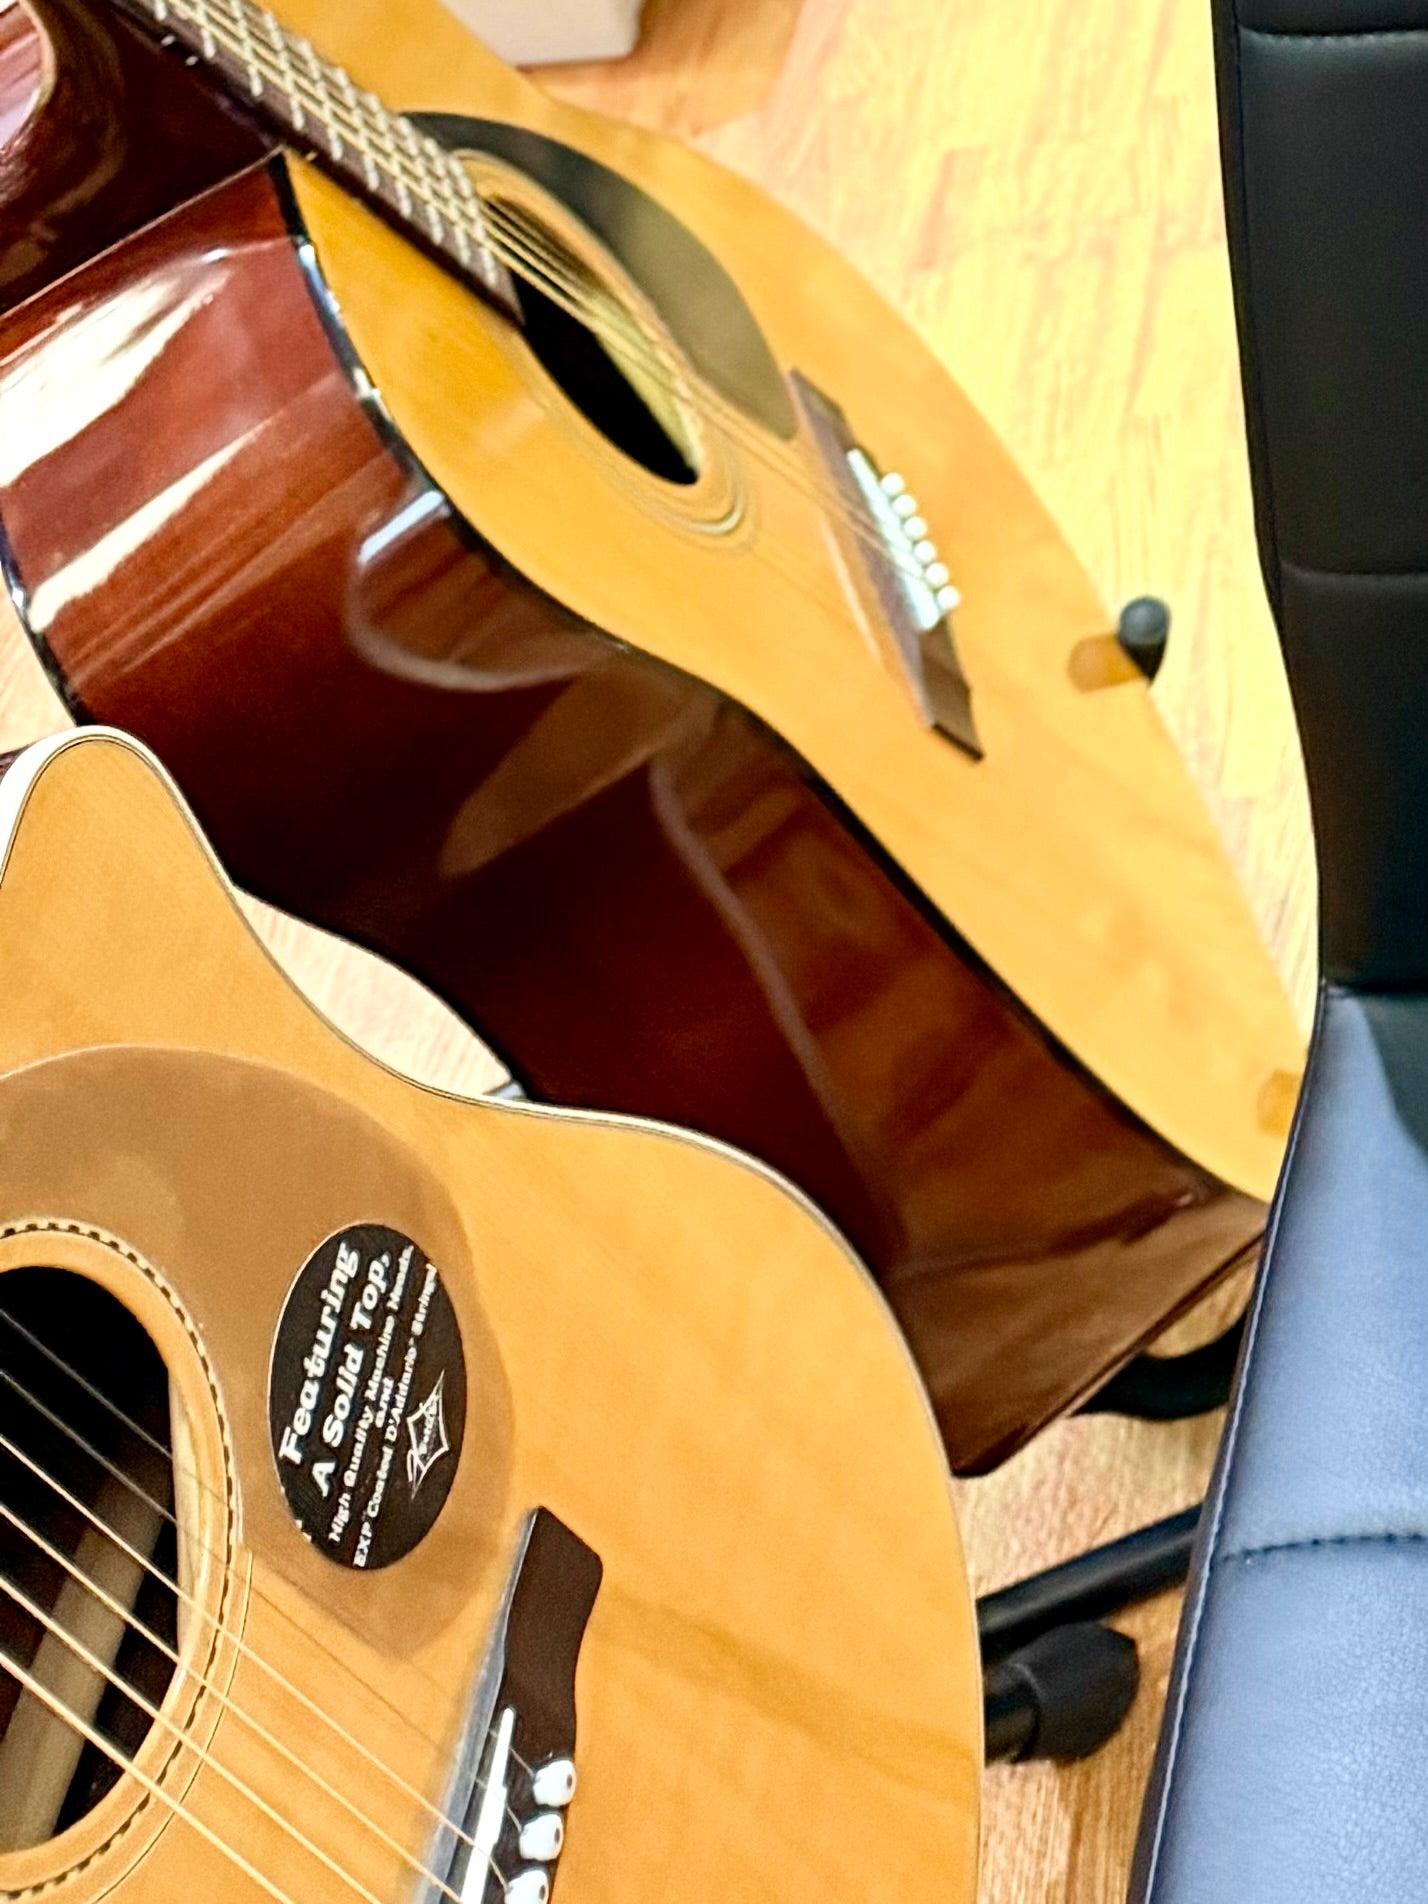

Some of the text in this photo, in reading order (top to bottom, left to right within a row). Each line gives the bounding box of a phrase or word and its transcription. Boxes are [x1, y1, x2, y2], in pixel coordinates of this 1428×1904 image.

[279, 1242, 360, 1465] Featuring
[312, 1251, 392, 1498] A Solid Top,
[328, 1493, 350, 1543] High
[344, 1406, 375, 1488] Quality
[365, 1315, 395, 1401] Machine
[375, 1377, 395, 1428] and
[367, 1445, 394, 1518] Coated
